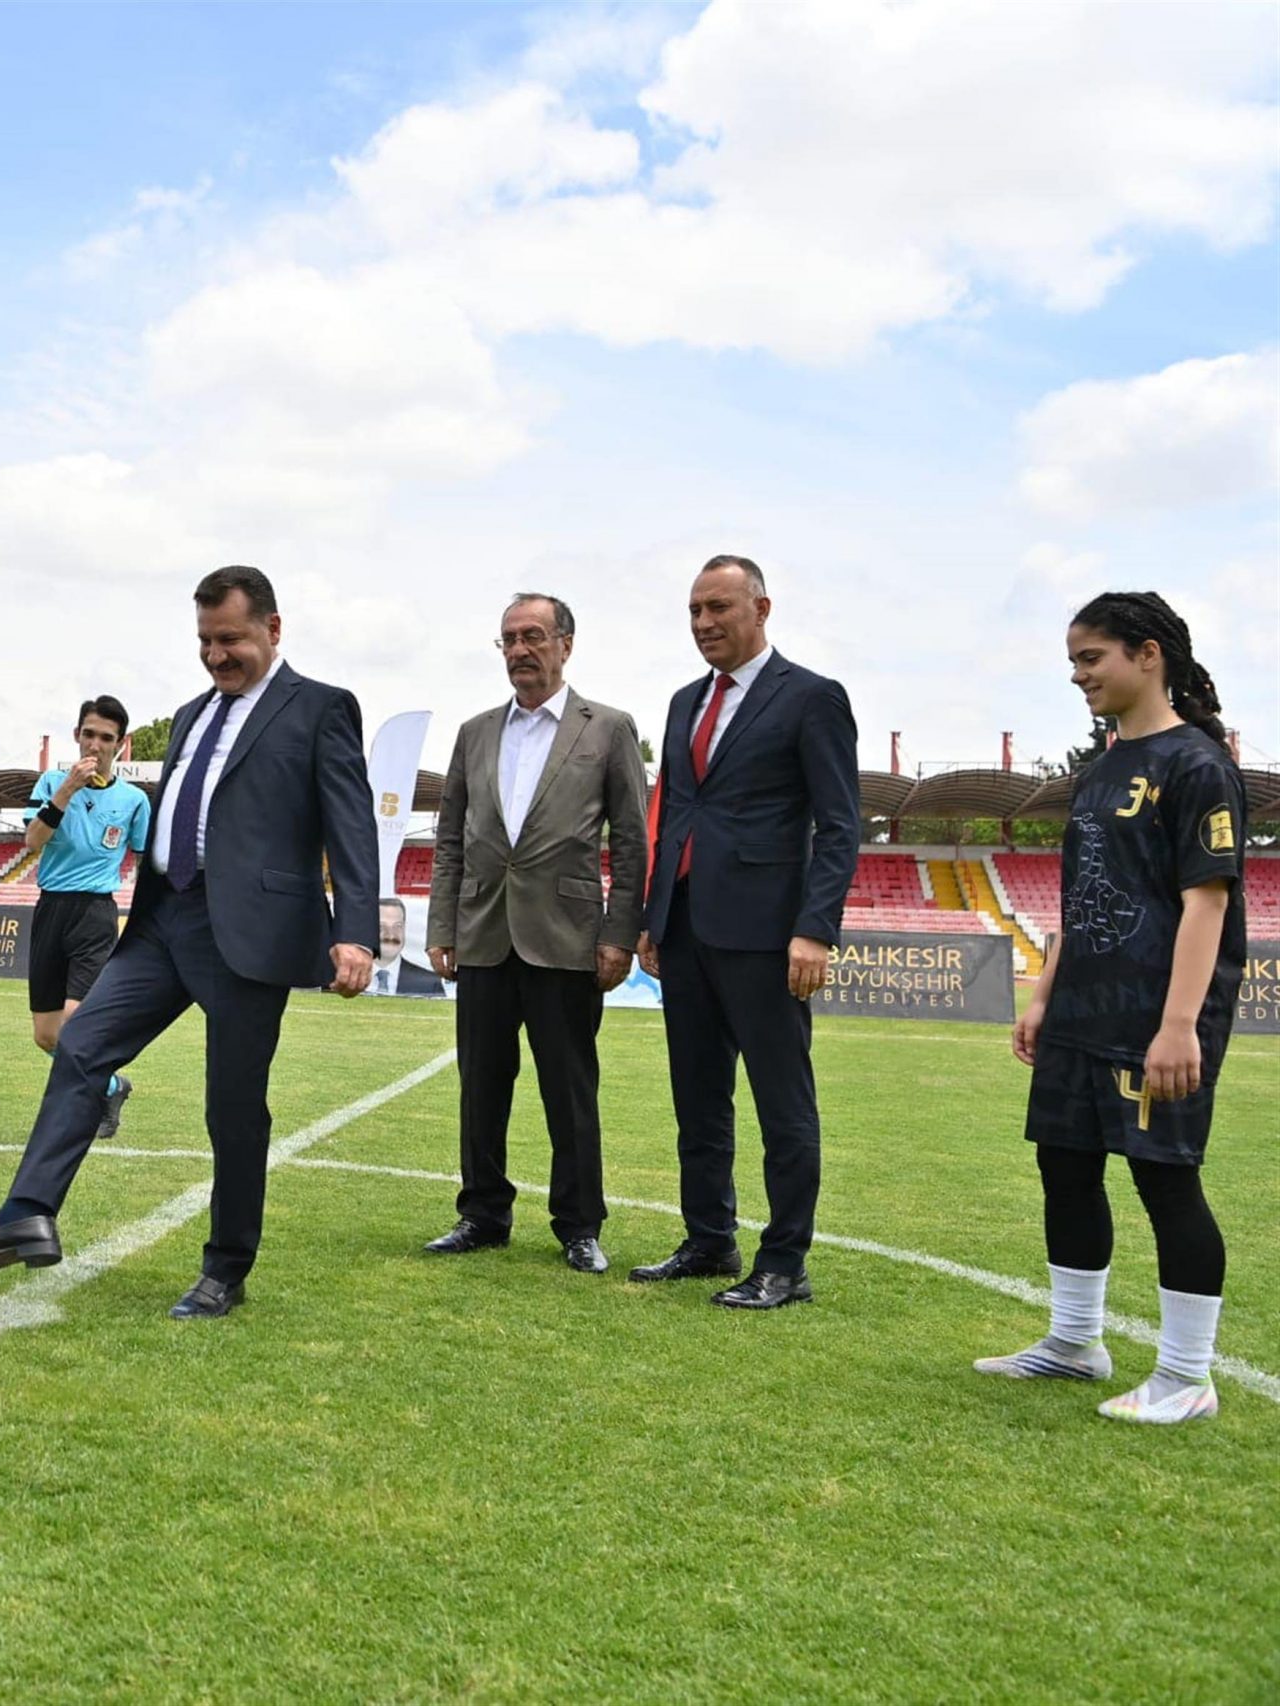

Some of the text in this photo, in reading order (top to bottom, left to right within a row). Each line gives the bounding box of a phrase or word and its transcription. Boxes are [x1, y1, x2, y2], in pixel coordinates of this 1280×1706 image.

[826, 944, 963, 970] BALIKESİR
[824, 966, 963, 992] BÜYÜKŞEHİR
[824, 989, 964, 1008] BELEDİYESİ
